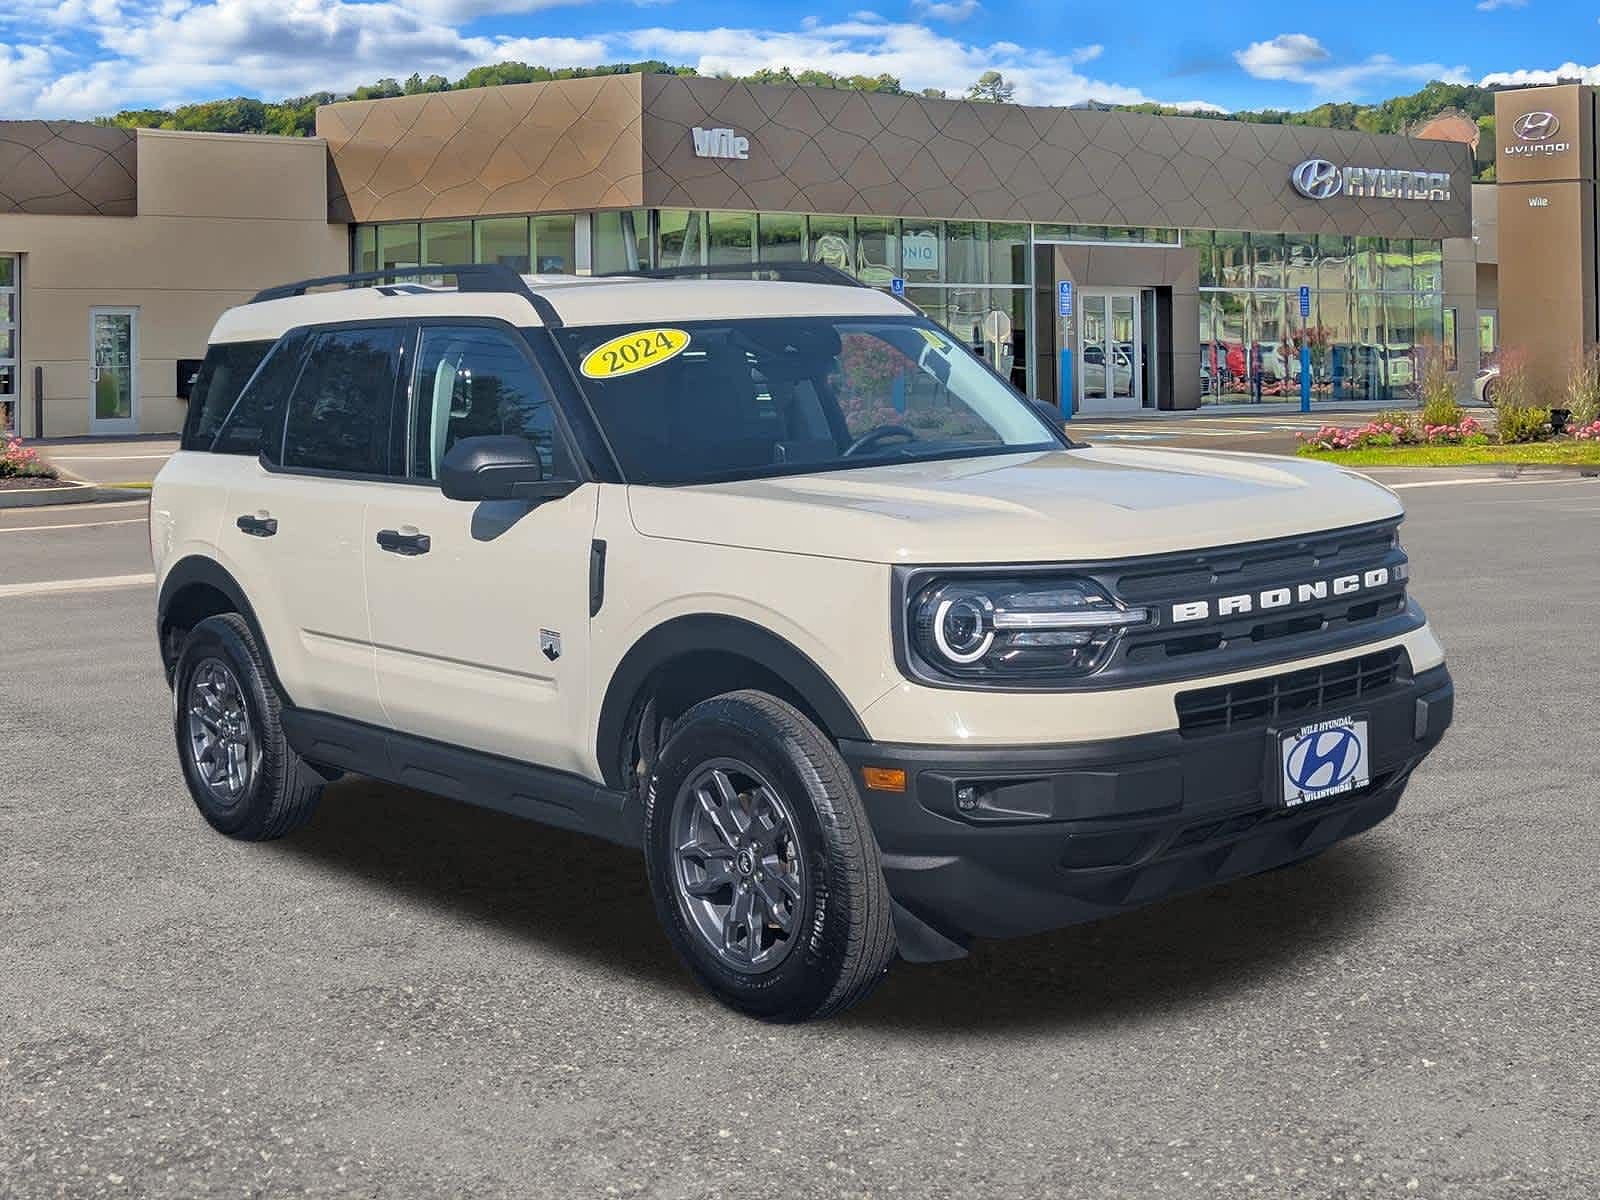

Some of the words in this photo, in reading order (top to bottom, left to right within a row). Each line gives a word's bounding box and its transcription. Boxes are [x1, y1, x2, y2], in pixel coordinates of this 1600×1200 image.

[692, 127, 749, 159] Wile
[1343, 167, 1450, 200] HYUNDAI
[602, 332, 673, 372] 2024
[1172, 567, 1388, 623] BRONCO
[1301, 724, 1318, 735] WILE
